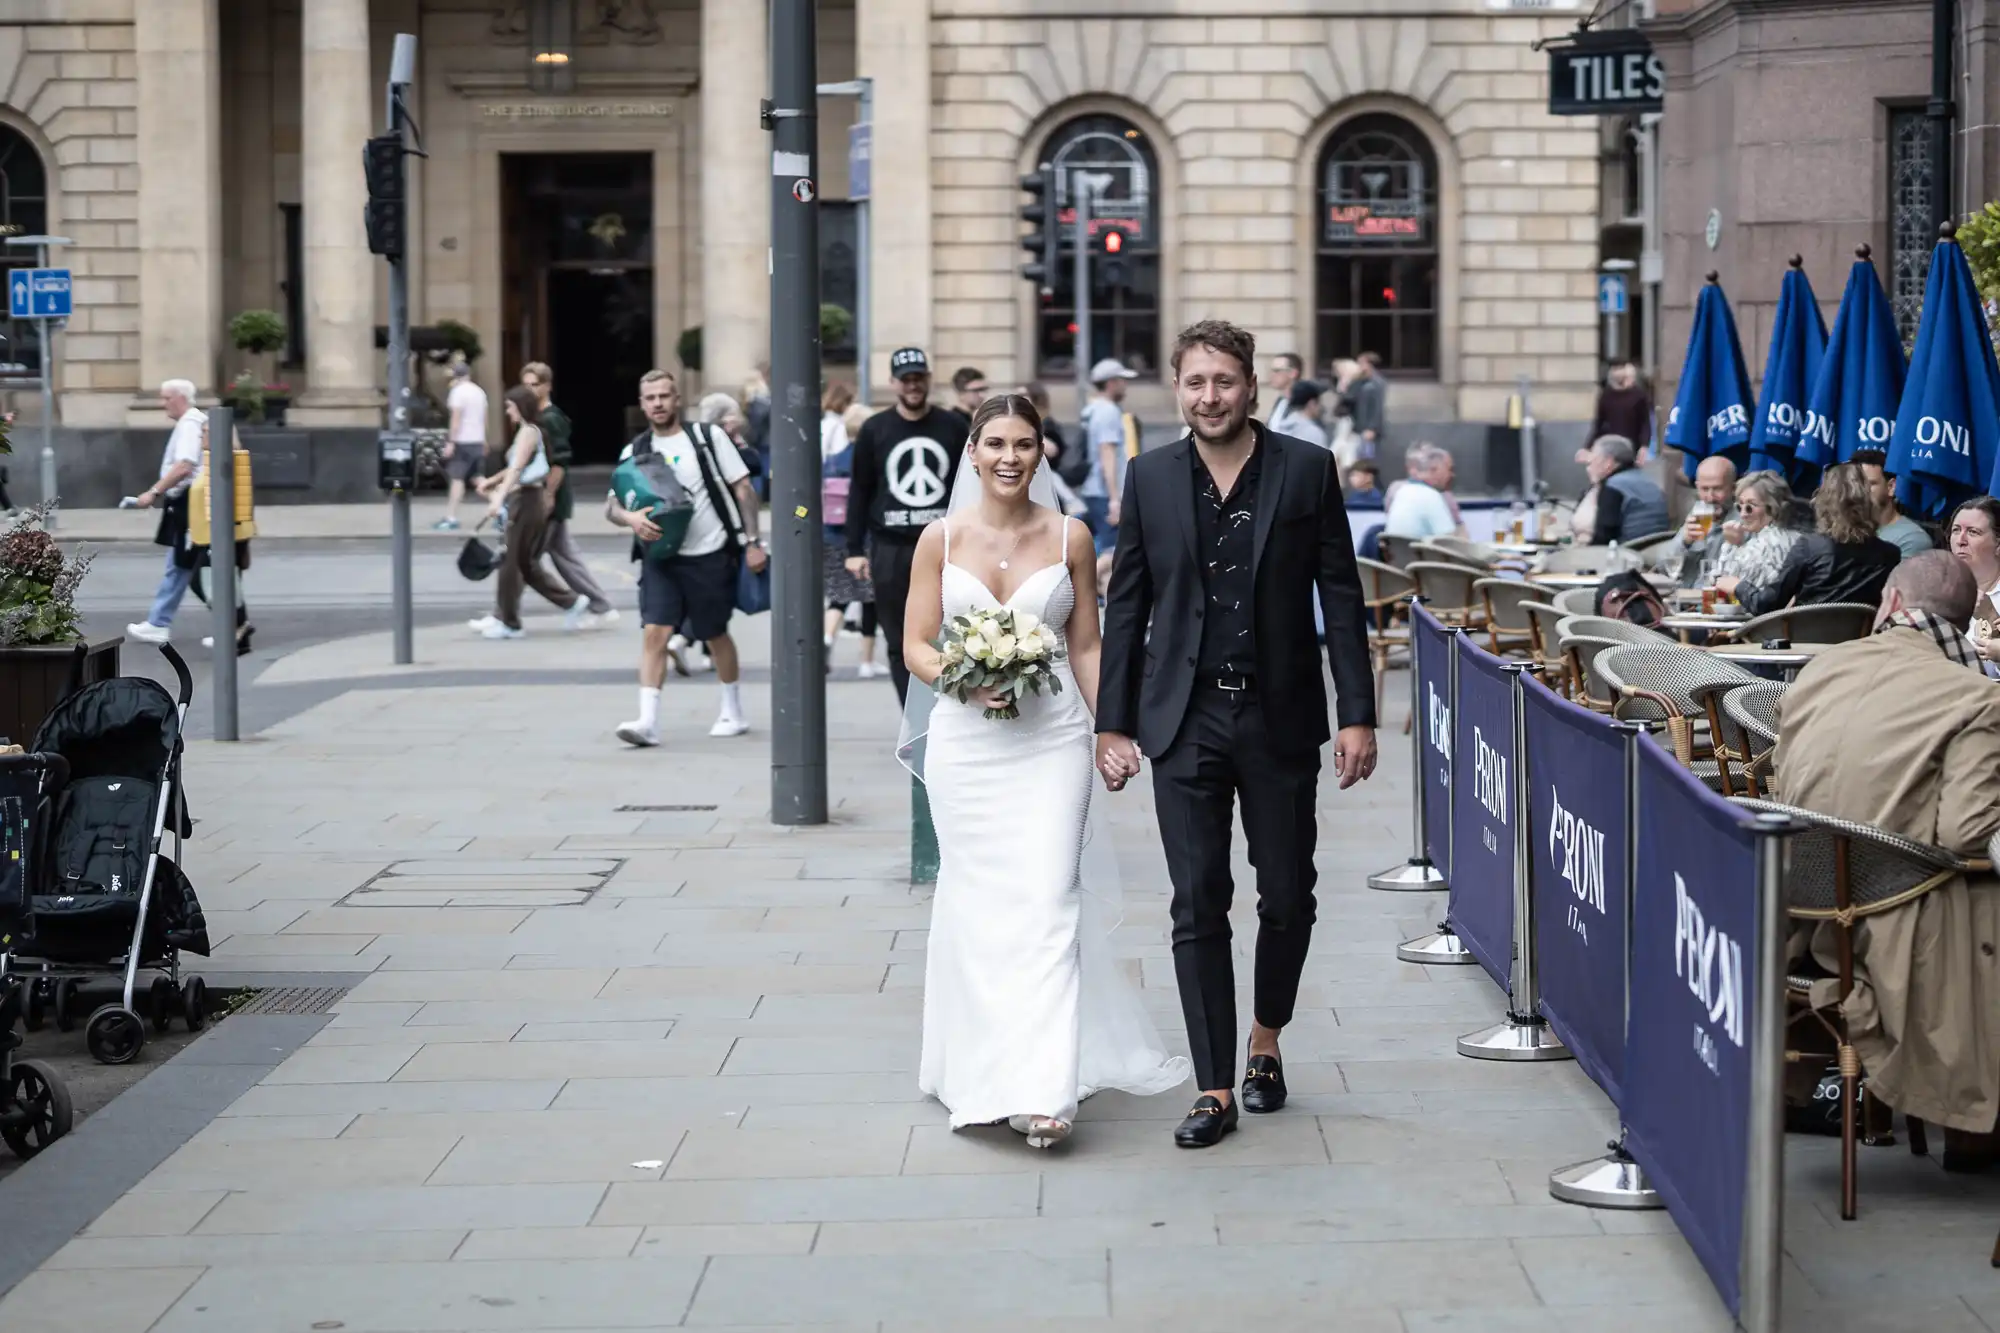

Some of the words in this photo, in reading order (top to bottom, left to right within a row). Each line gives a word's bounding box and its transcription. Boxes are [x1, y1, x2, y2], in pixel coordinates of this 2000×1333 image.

[1569, 54, 1665, 101] TILES
[1913, 406, 1970, 457] ONI
[1473, 724, 1507, 826] PERONI
[111, 873, 122, 892] Joie
